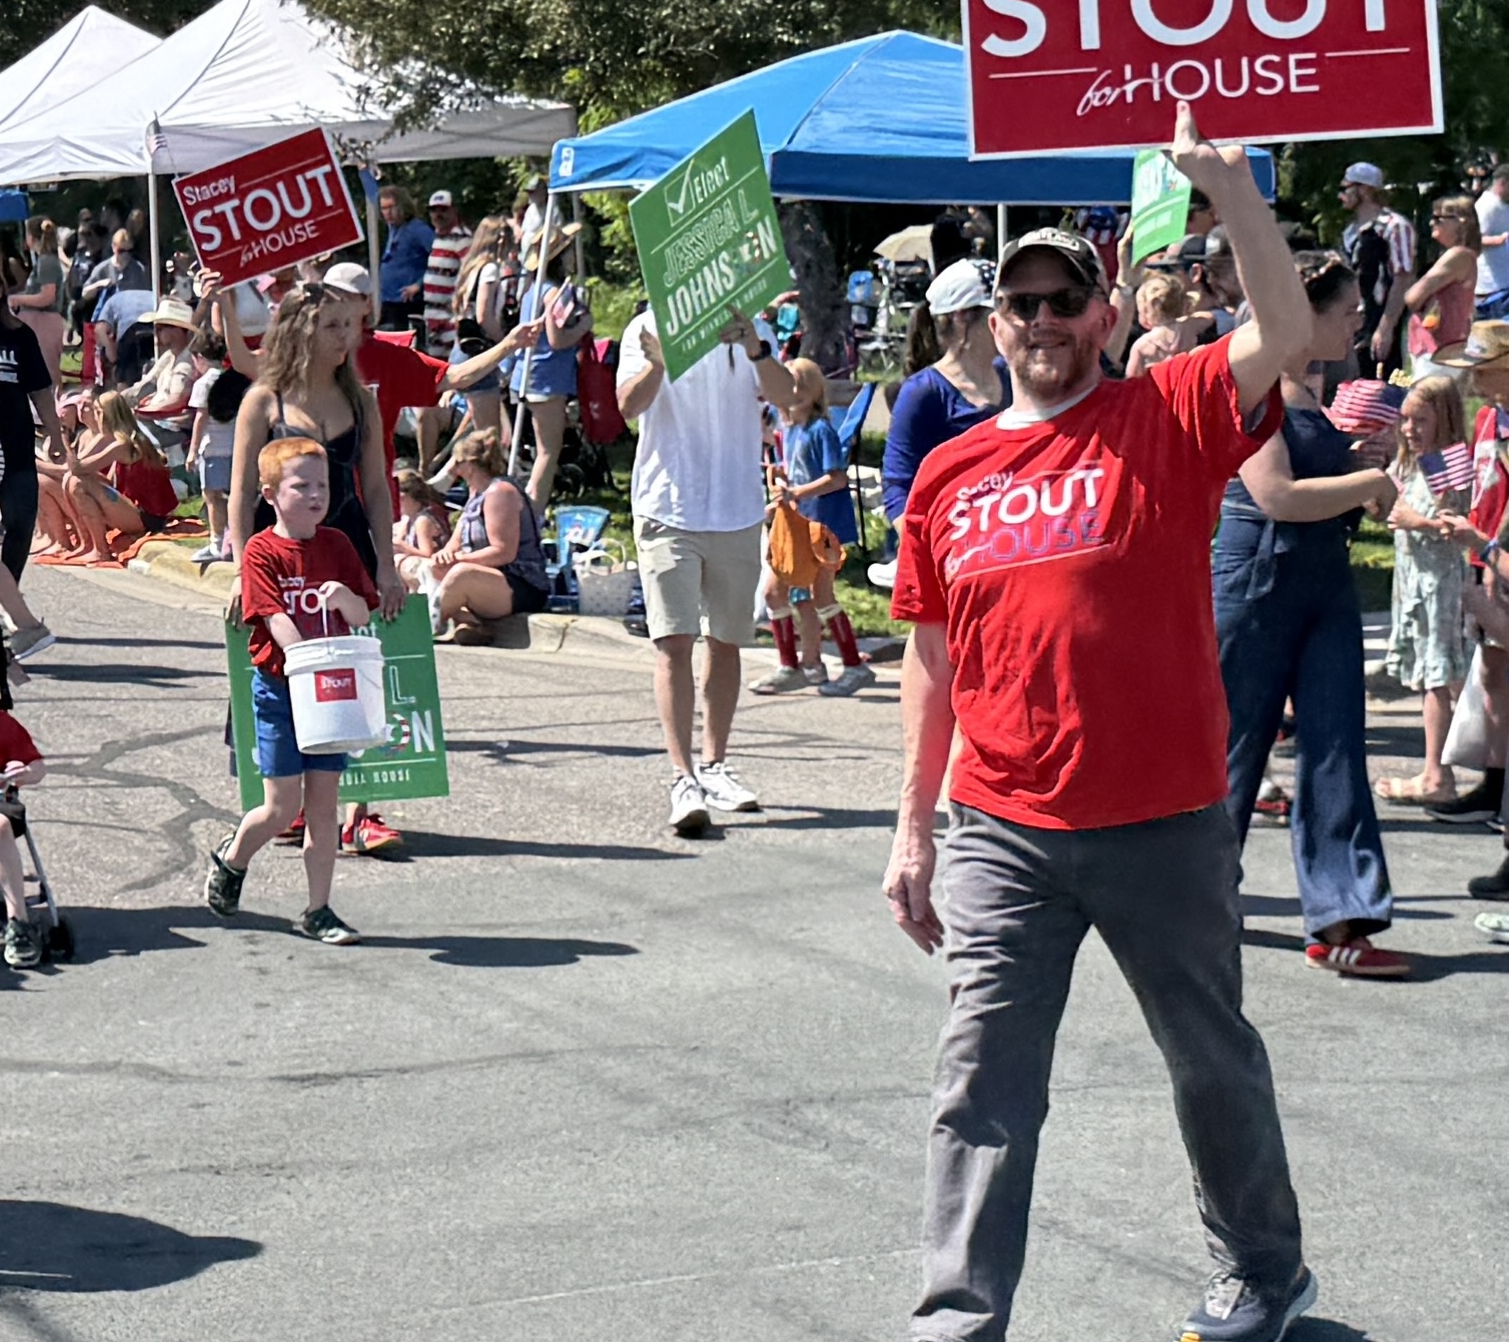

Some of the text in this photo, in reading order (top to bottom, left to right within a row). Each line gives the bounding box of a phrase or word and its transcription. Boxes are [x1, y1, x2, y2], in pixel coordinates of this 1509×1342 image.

[1123, 52, 1320, 104] HOUSE
[182, 174, 236, 206] Stacey
[692, 156, 731, 205] Elect
[192, 163, 334, 252] STOUT
[250, 219, 320, 259] HOUSE
[663, 196, 740, 288] JESSICA
[947, 467, 1105, 542] STOUT
